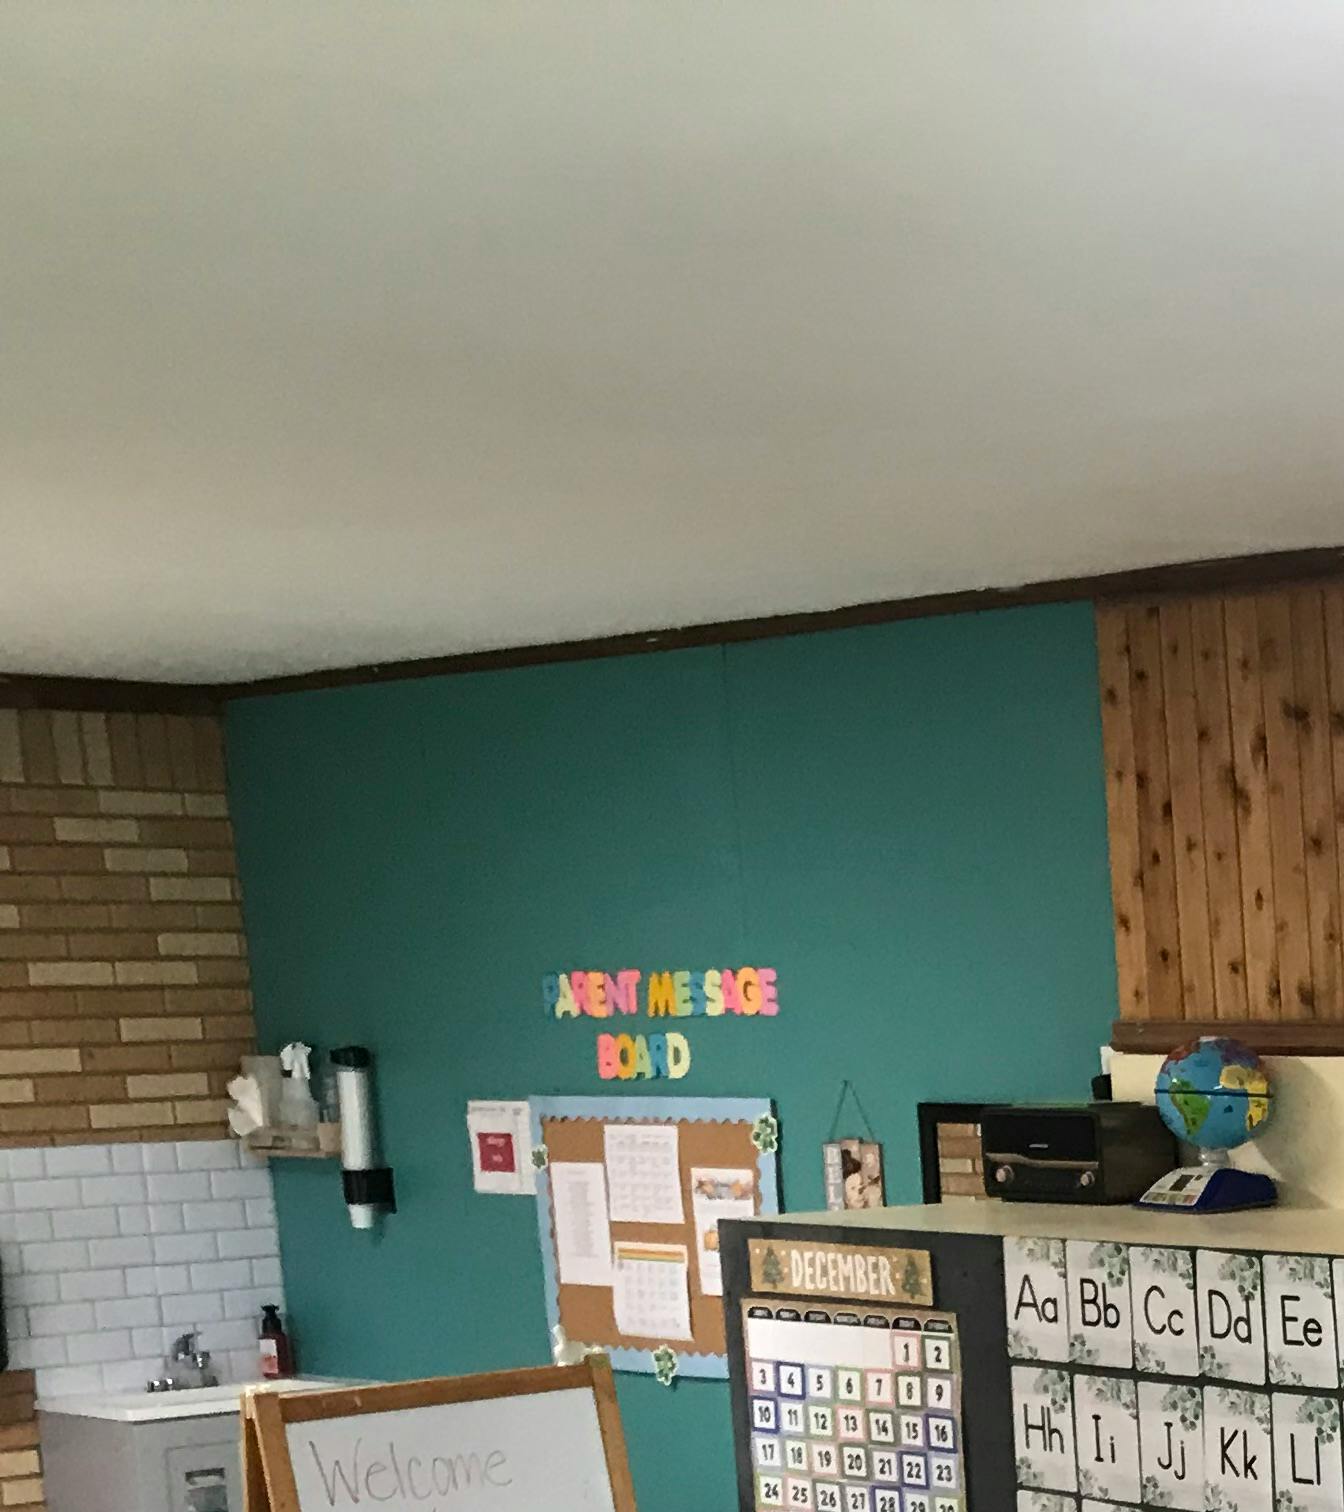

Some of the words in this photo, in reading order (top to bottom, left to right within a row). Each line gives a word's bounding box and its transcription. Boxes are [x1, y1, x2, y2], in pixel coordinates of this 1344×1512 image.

[542, 968, 641, 1019] PARENT
[648, 966, 781, 1018] MESSAGE
[596, 1032, 691, 1081] BOARD
[790, 1249, 895, 1296] DECEMBER
[1014, 1275, 1058, 1324] Aa
[1080, 1278, 1120, 1328] Bb
[1144, 1286, 1184, 1338] Cc
[1208, 1289, 1252, 1344] Dd
[1281, 1296, 1323, 1347] Ee
[902, 1342, 911, 1363] 1
[934, 1346, 942, 1364] 2
[760, 1369, 767, 1386] 3
[787, 1372, 795, 1389] 4
[816, 1375, 824, 1392] 5
[846, 1377, 853, 1395] 6
[875, 1379, 883, 1397] 7
[906, 1382, 914, 1400] 8
[936, 1384, 944, 1402] 9
[1024, 1403, 1065, 1454] Hh
[1092, 1414, 1115, 1464] Ii
[1157, 1422, 1186, 1481] Jj
[1220, 1428, 1258, 1480] Kk
[308, 1437, 512, 1506] Welcome
[1291, 1434, 1321, 1486] Ll
[763, 1484, 778, 1501] 24
[792, 1486, 808, 1504] 25
[820, 1490, 836, 1508] 26
[851, 1493, 865, 1511] 27
